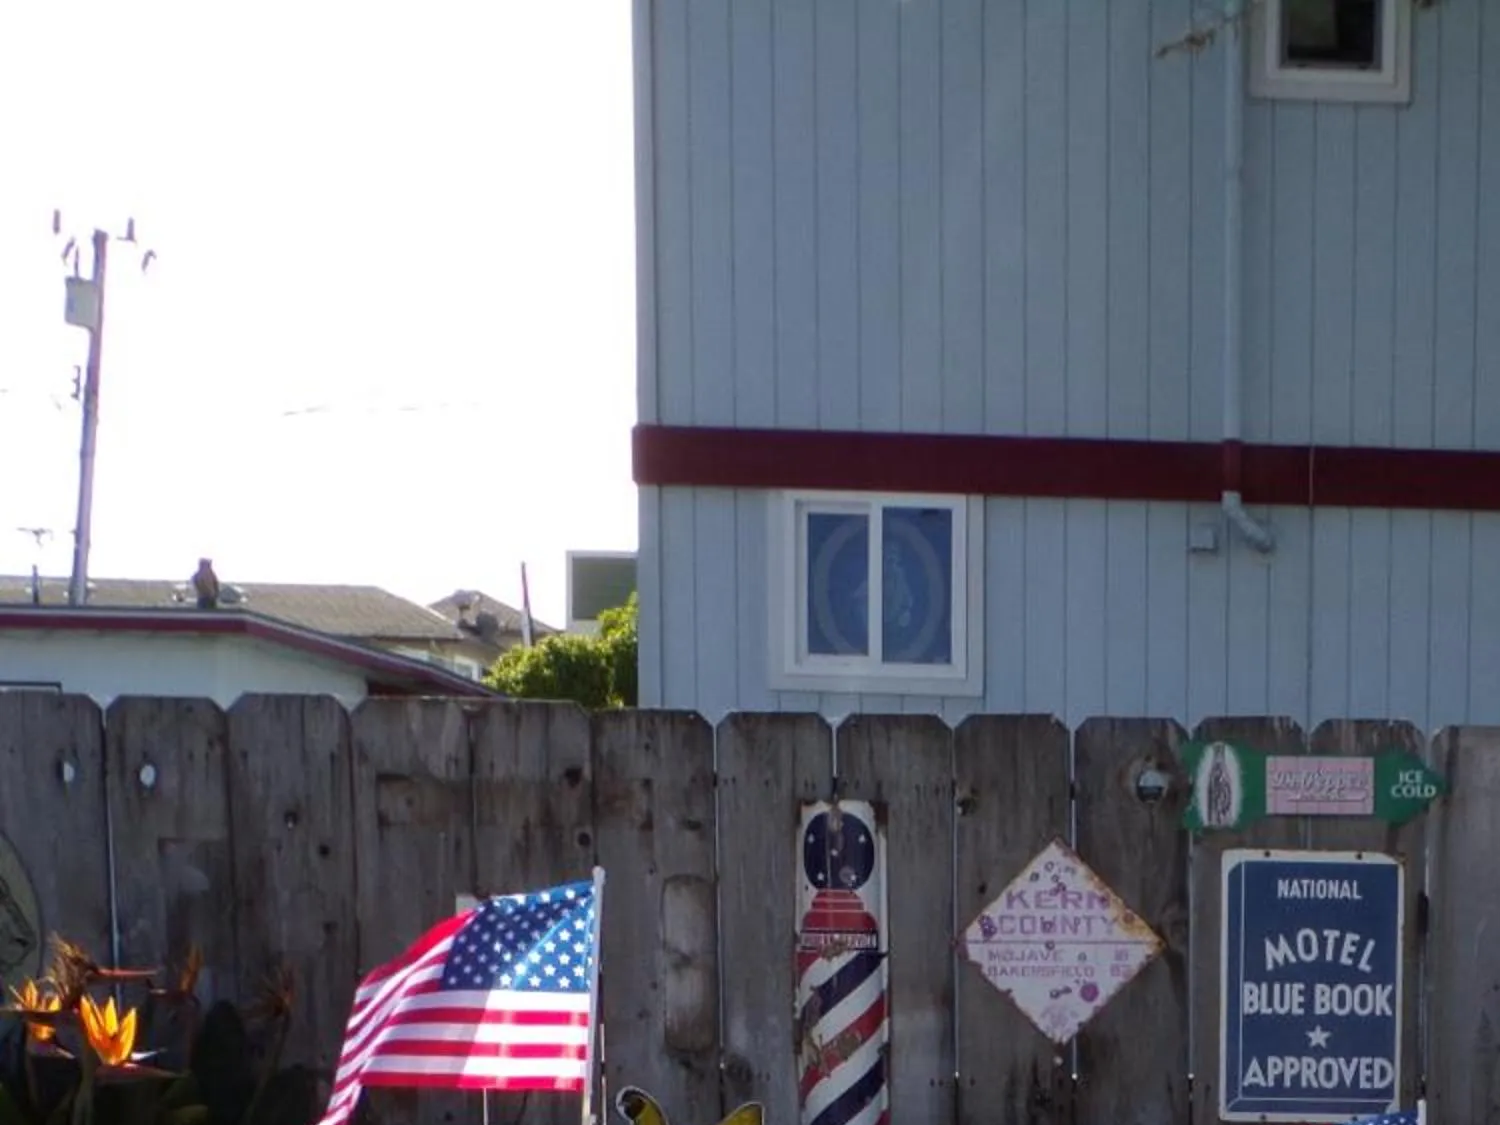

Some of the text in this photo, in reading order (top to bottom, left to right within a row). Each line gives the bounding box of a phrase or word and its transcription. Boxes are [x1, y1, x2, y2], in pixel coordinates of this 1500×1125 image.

[1399, 770, 1424, 783] ICE
[1391, 785, 1436, 798] COLD
[1278, 879, 1362, 899] NATIONAL
[1006, 890, 1111, 910] KERN
[999, 915, 1117, 936] COUNTY
[1265, 928, 1375, 973] MOTEL
[1243, 982, 1393, 1016] BLUE BOOK
[1243, 1055, 1394, 1089] APPROVED
